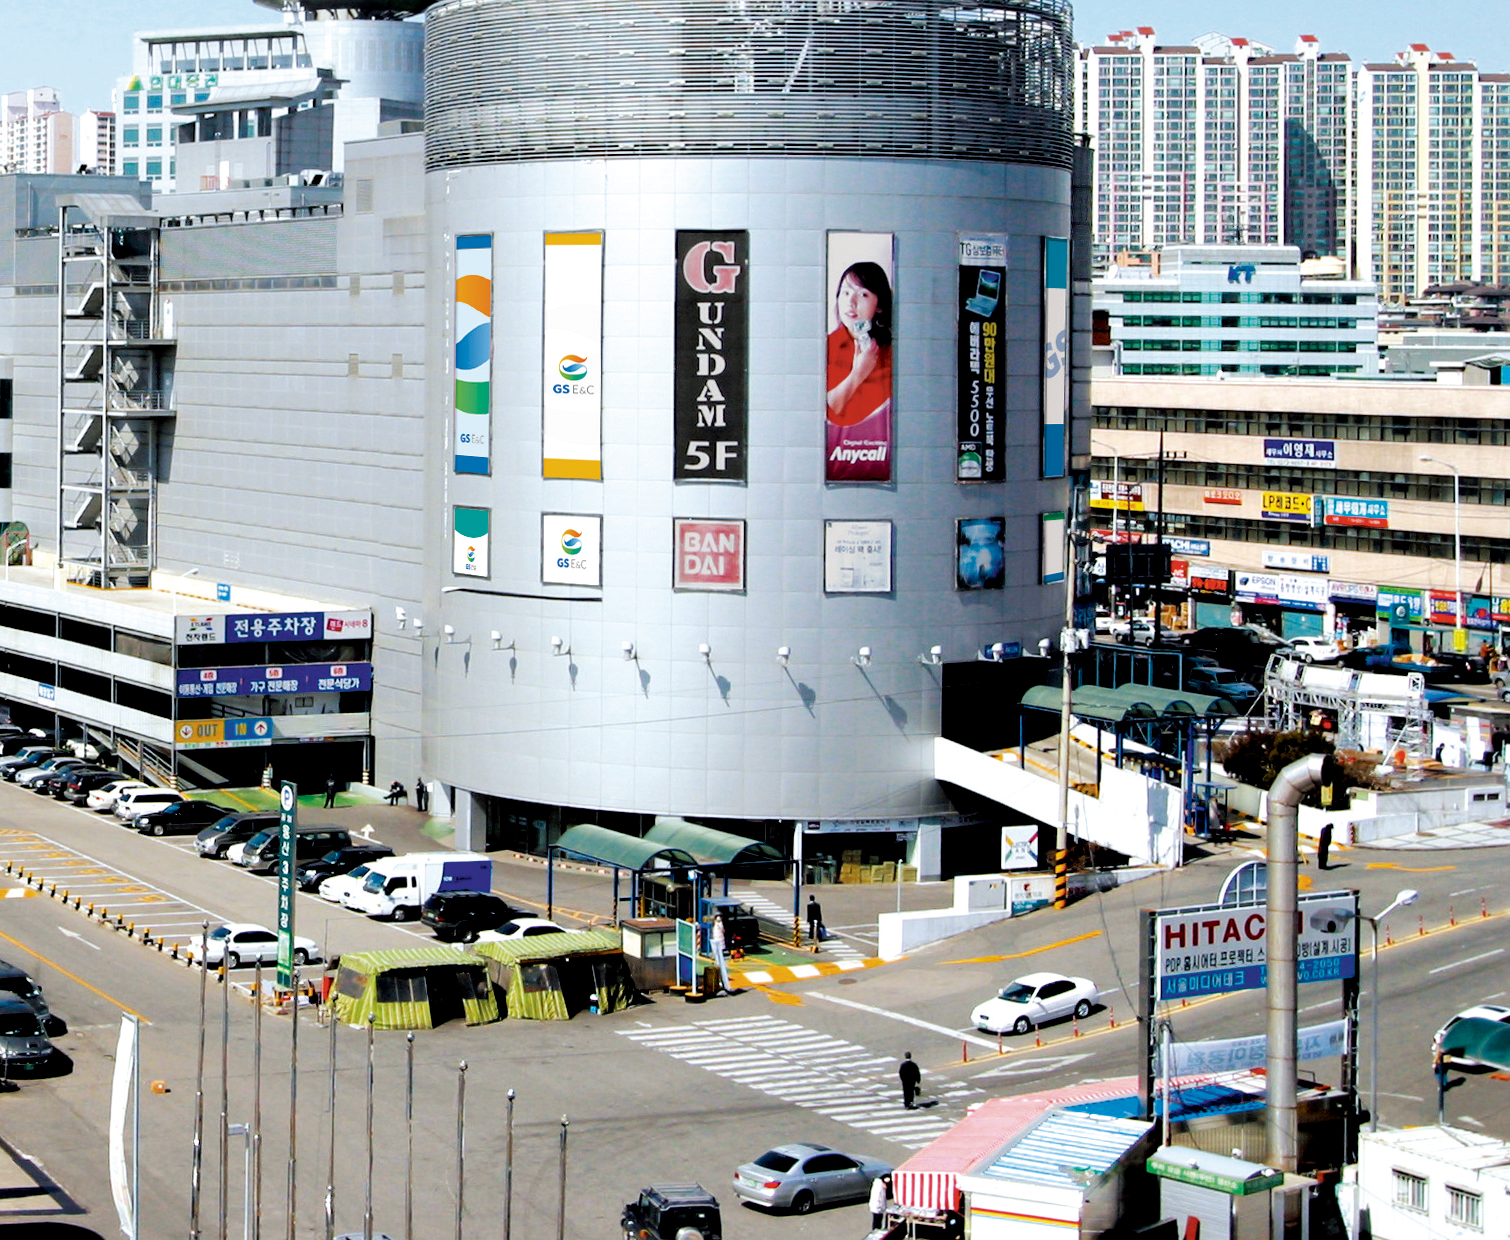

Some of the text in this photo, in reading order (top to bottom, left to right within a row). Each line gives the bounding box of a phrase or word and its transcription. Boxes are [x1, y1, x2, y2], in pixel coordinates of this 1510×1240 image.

[1227, 265, 1256, 284] KT
[683, 241, 740, 427] GUNDAM
[553, 384, 594, 395] GS E&C
[970, 380, 980, 437] 5500
[460, 433, 470, 443] GS
[684, 441, 738, 471] 5F
[830, 446, 886, 464] Anycall
[1283, 442, 1314, 458] 이영재
[684, 531, 734, 554] BAN
[557, 558, 587, 569] GS E&C
[684, 557, 725, 576] DAI
[1252, 576, 1277, 586] EPSON
[234, 617, 316, 639] 전용주차장
[250, 680, 266, 693] 가구
[198, 723, 218, 737] OUT
[235, 722, 248, 736] IN
[1165, 911, 1303, 950] HITACI
[1166, 970, 1245, 994] 서울미디어테크
